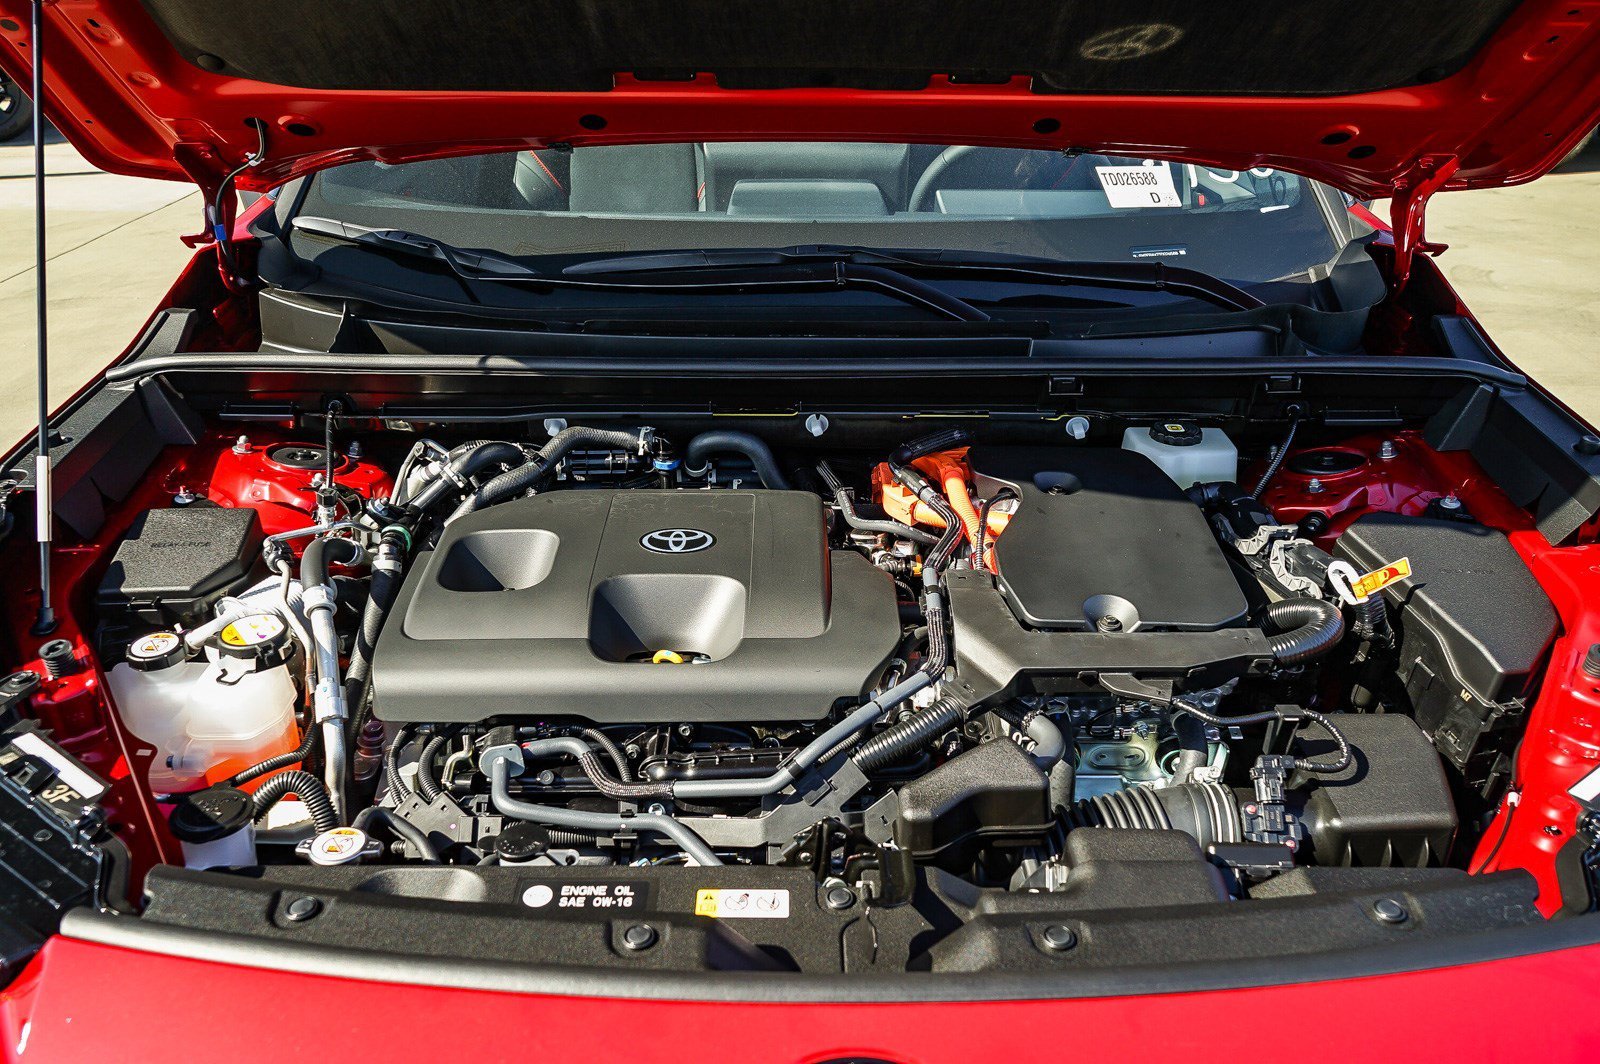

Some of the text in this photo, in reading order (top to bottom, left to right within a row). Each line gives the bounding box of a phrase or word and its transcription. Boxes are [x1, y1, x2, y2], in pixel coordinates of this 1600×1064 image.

[1101, 172, 1158, 187] TD026588
[1150, 192, 1161, 204] D
[42, 785, 81, 803] 3F
[561, 886, 635, 896] ENGINE OIL
[559, 897, 633, 907] SAE 0W-16
